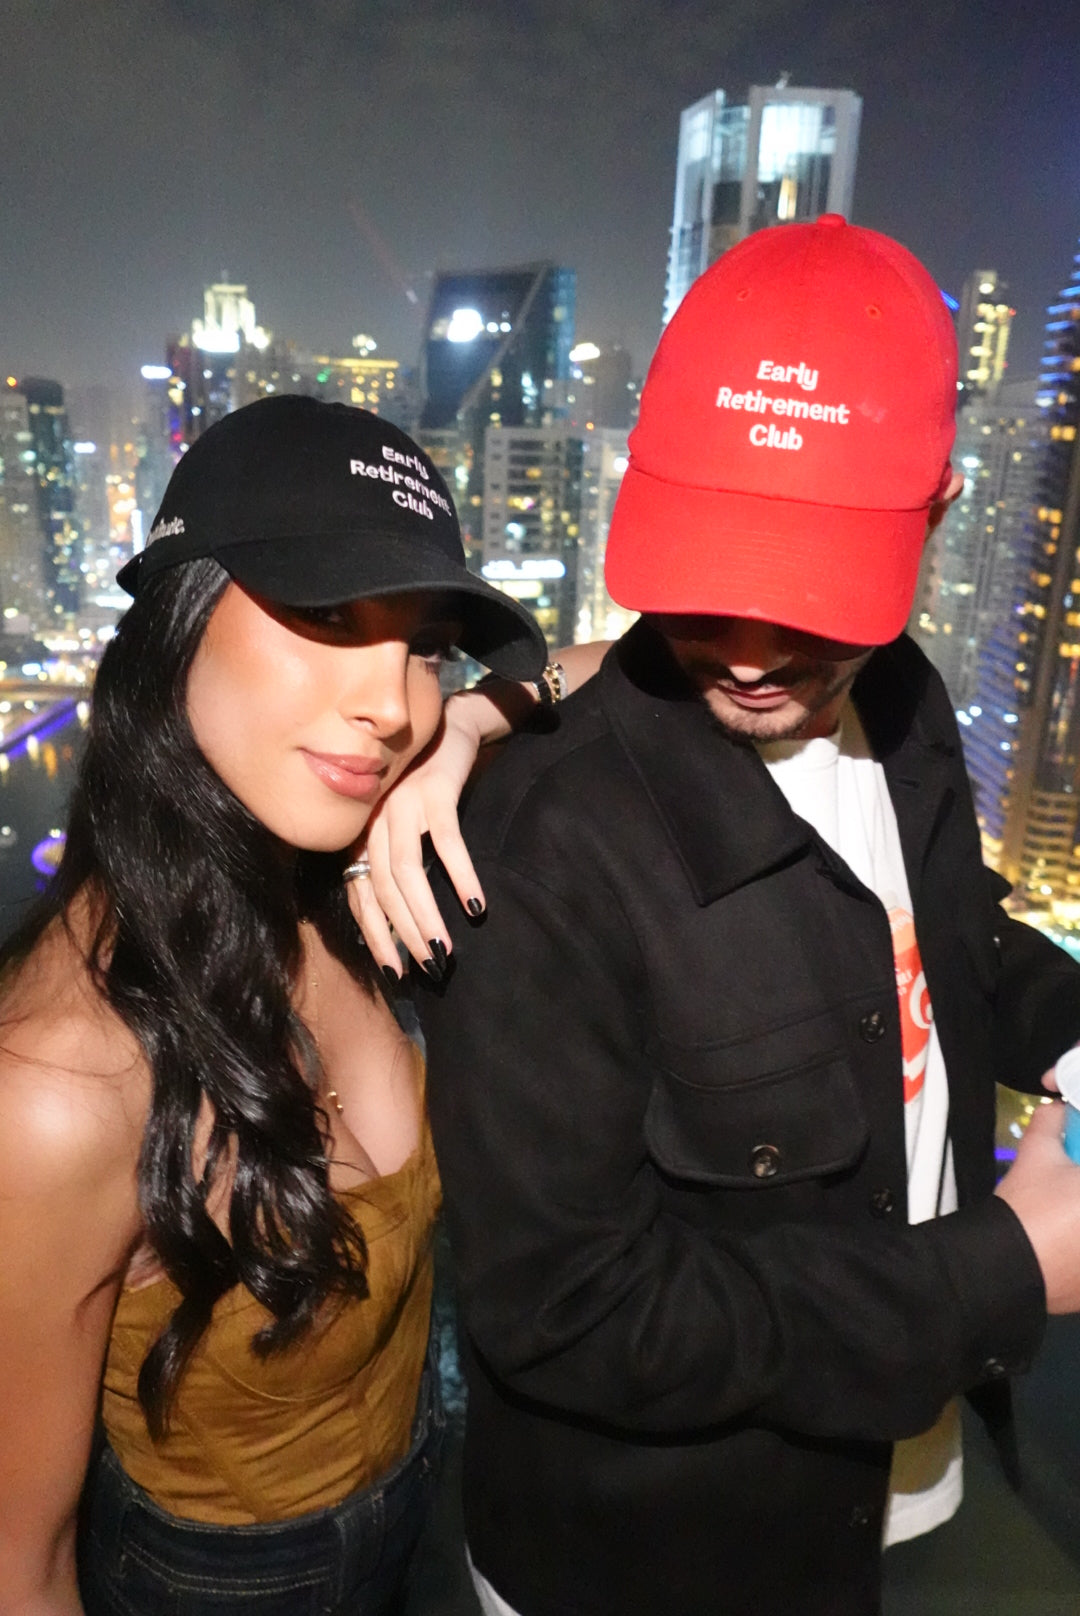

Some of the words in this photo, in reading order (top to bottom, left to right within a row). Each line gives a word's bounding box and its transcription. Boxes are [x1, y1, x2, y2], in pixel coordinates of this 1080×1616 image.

[756, 360, 819, 391] Early
[715, 386, 851, 425] Retirement
[749, 423, 804, 451] Club
[381, 445, 430, 480] Early
[349, 458, 452, 517] Retirement
[392, 490, 434, 520] Club
